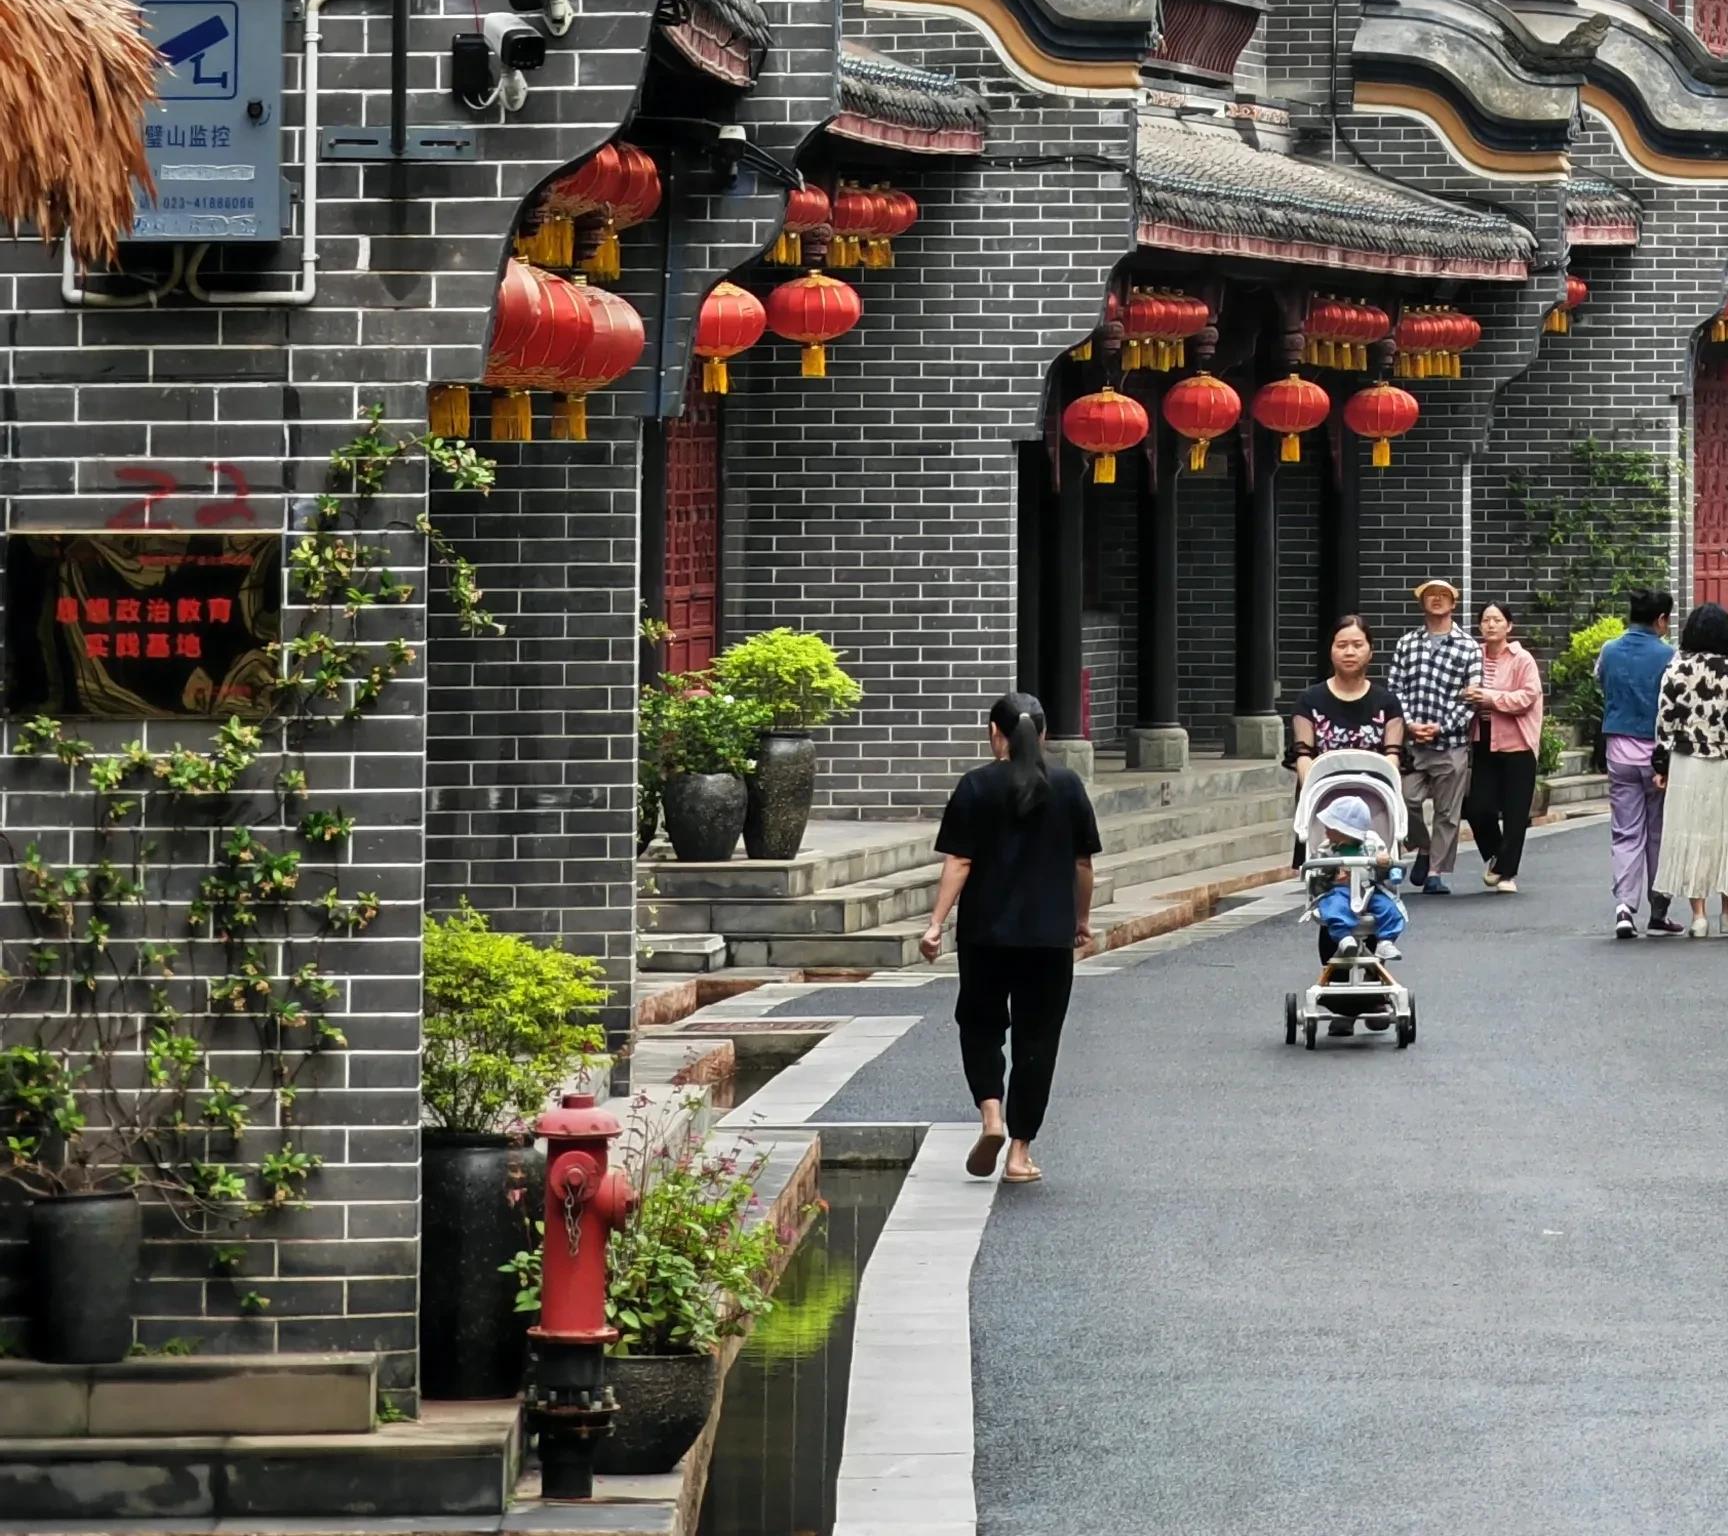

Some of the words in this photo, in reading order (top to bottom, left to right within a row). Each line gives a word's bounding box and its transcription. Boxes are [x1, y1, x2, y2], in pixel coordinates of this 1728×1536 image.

[145, 125, 231, 148] 璧山监控
[56, 597, 232, 624] 思想政治教育
[85, 632, 201, 658] 实践基地
